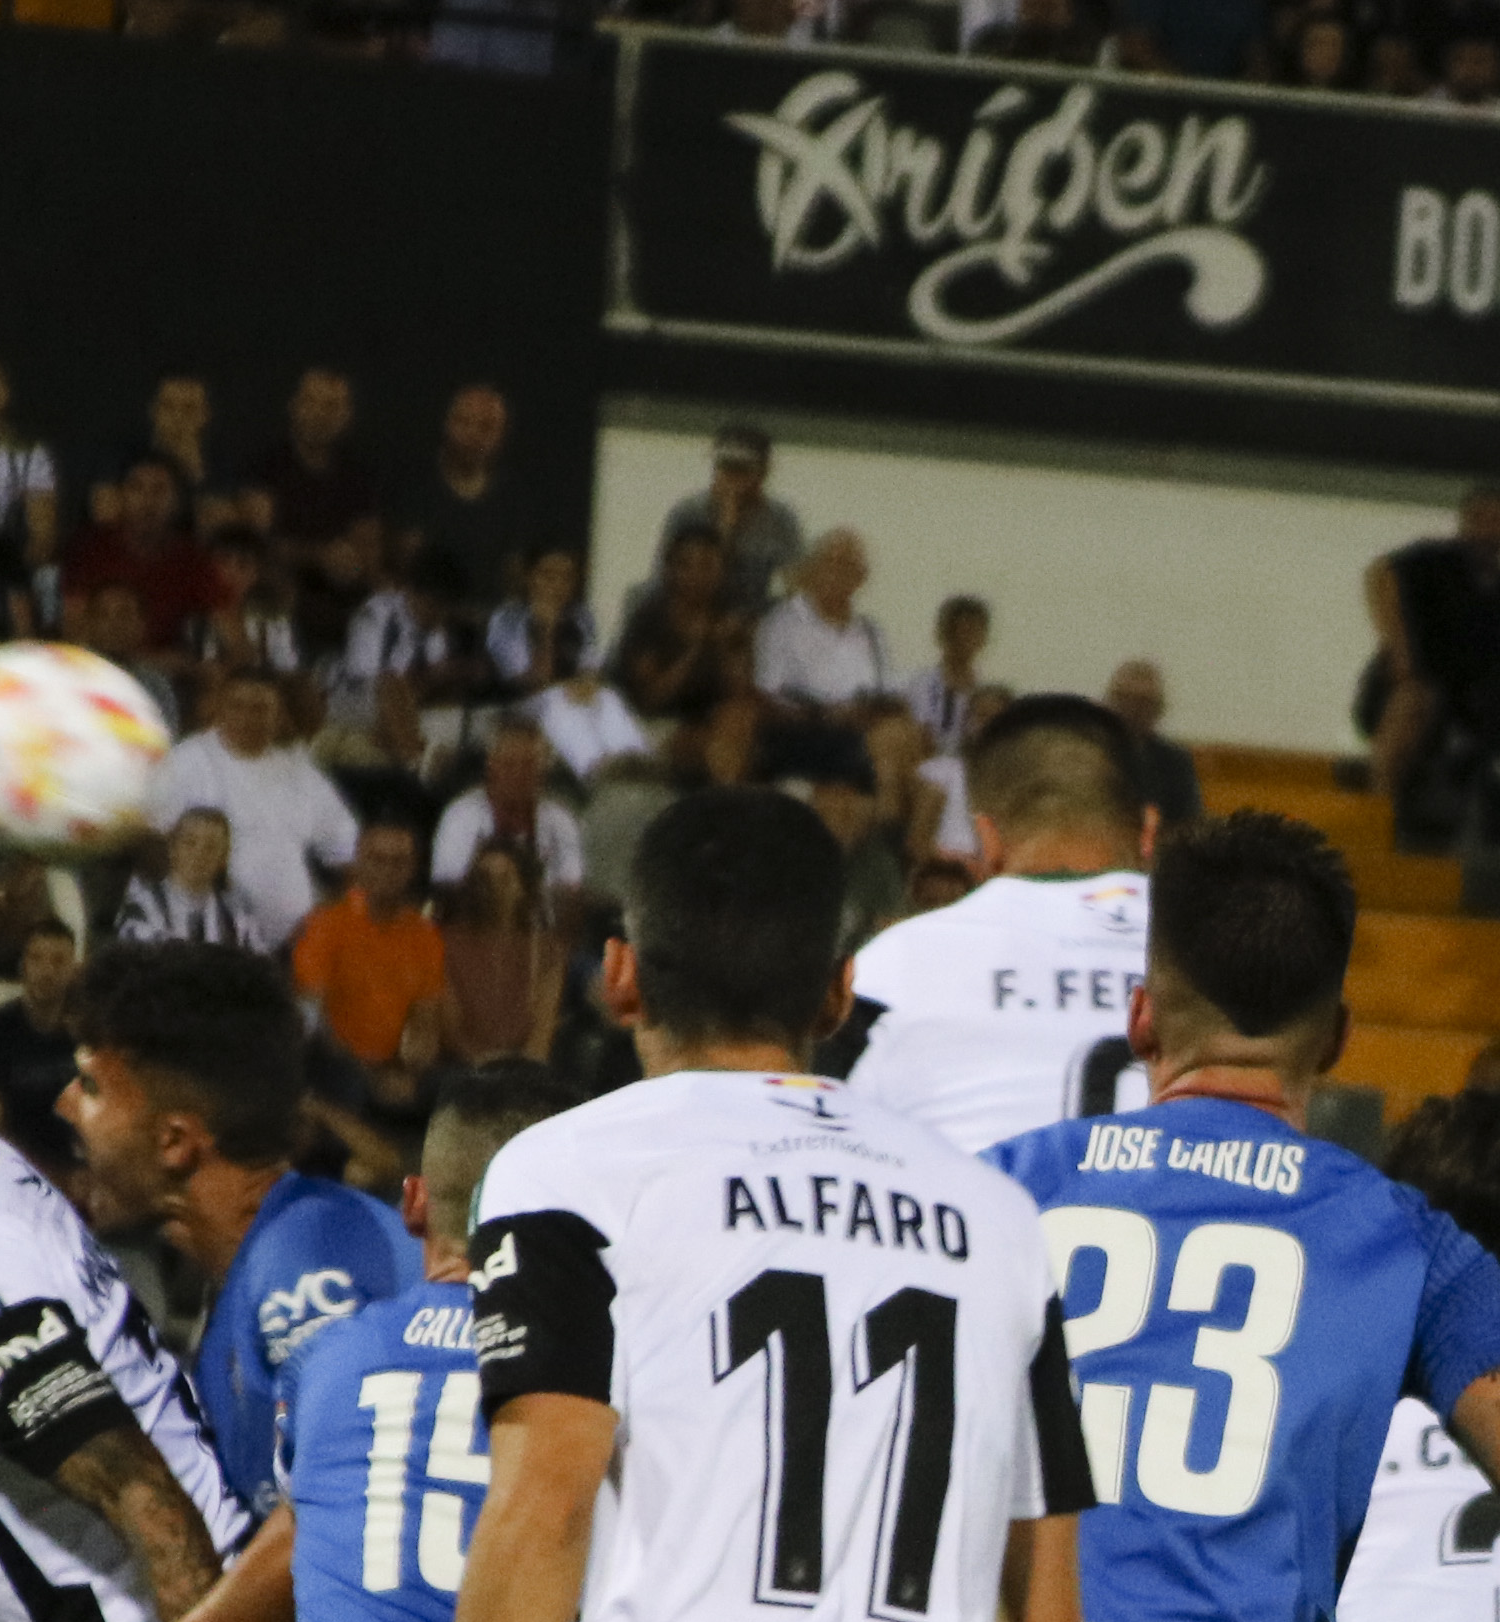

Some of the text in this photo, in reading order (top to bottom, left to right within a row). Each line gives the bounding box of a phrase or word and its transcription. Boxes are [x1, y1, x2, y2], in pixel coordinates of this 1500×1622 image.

[723, 1173, 971, 1263] ALFARO
[1076, 1123, 1306, 1196] JOSE CARLOS
[1040, 1204, 1307, 1519] 23
[357, 1369, 492, 1595] 15
